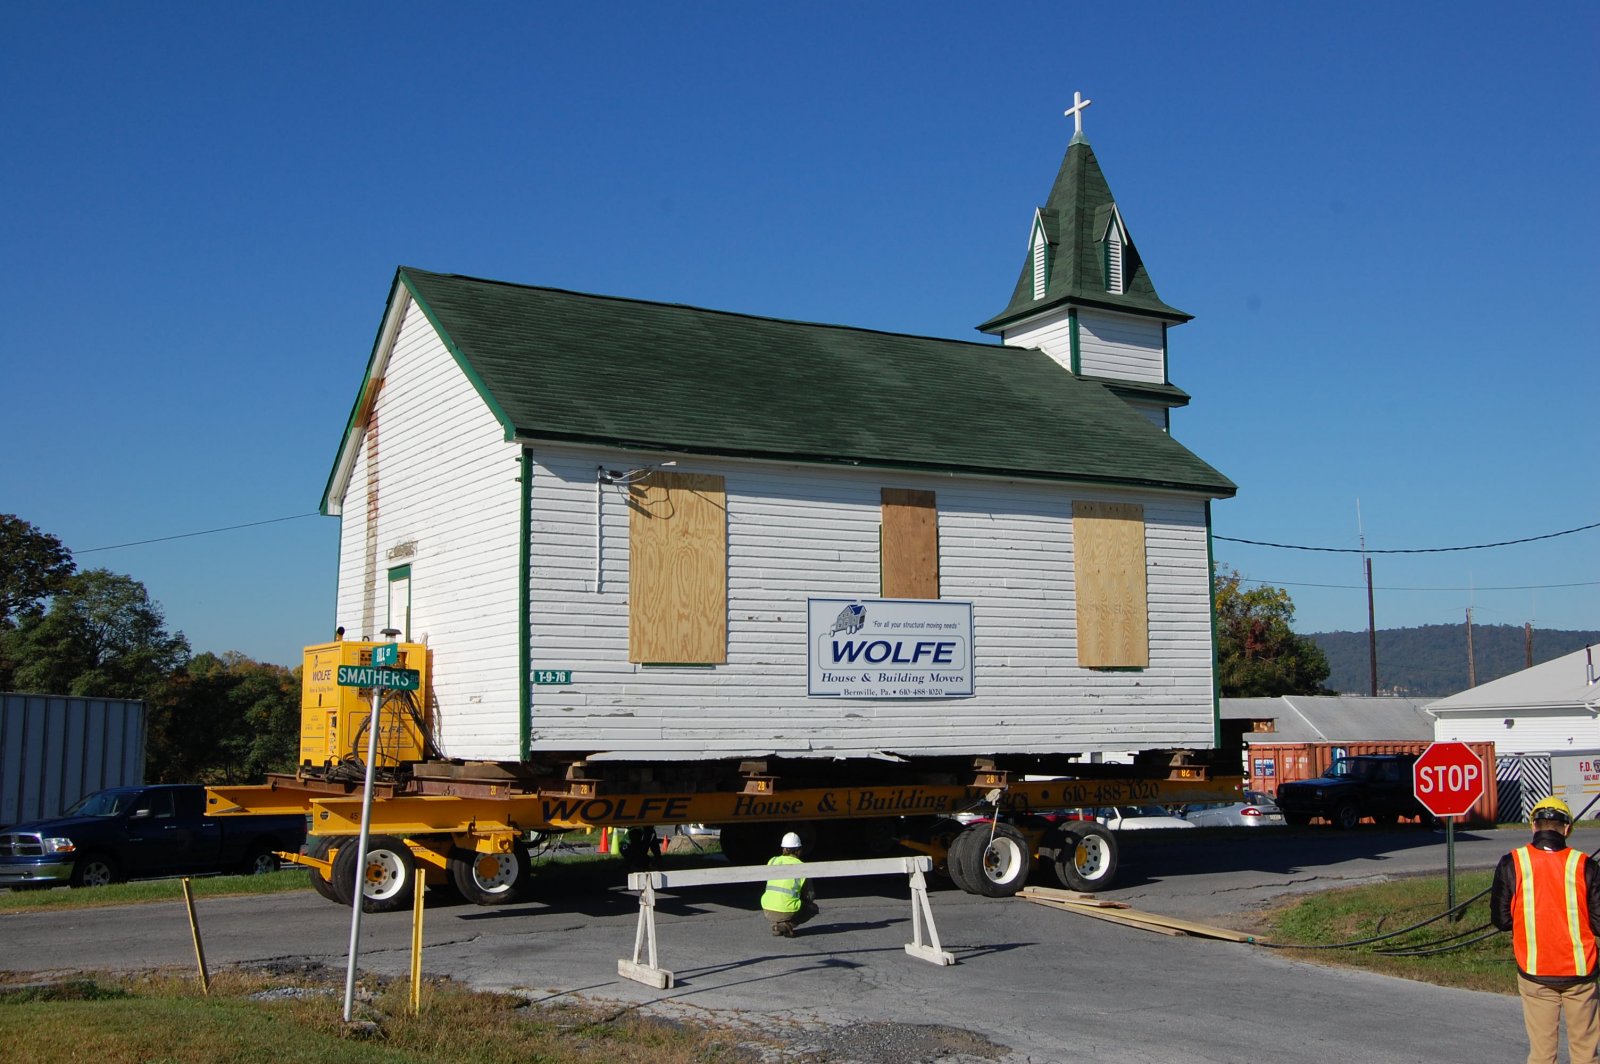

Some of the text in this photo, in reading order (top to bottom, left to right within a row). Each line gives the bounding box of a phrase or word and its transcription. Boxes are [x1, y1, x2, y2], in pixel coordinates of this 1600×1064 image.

[903, 621, 925, 629] structural
[926, 622, 942, 630] moving
[831, 640, 956, 664] WOLFE
[313, 670, 331, 680] WOLFE
[338, 668, 409, 686] SMATHERS
[538, 671, 566, 682] T-9-76
[821, 673, 964, 684] House & Building Movers
[843, 689, 878, 697] Bernville,
[1579, 761, 1593, 773] F.D.
[1419, 765, 1478, 793] STOP
[733, 796, 803, 816] House
[817, 792, 838, 812] &
[857, 789, 949, 811] Building
[1062, 782, 1160, 801] 610-488-1020
[541, 797, 691, 822] WOLFE
